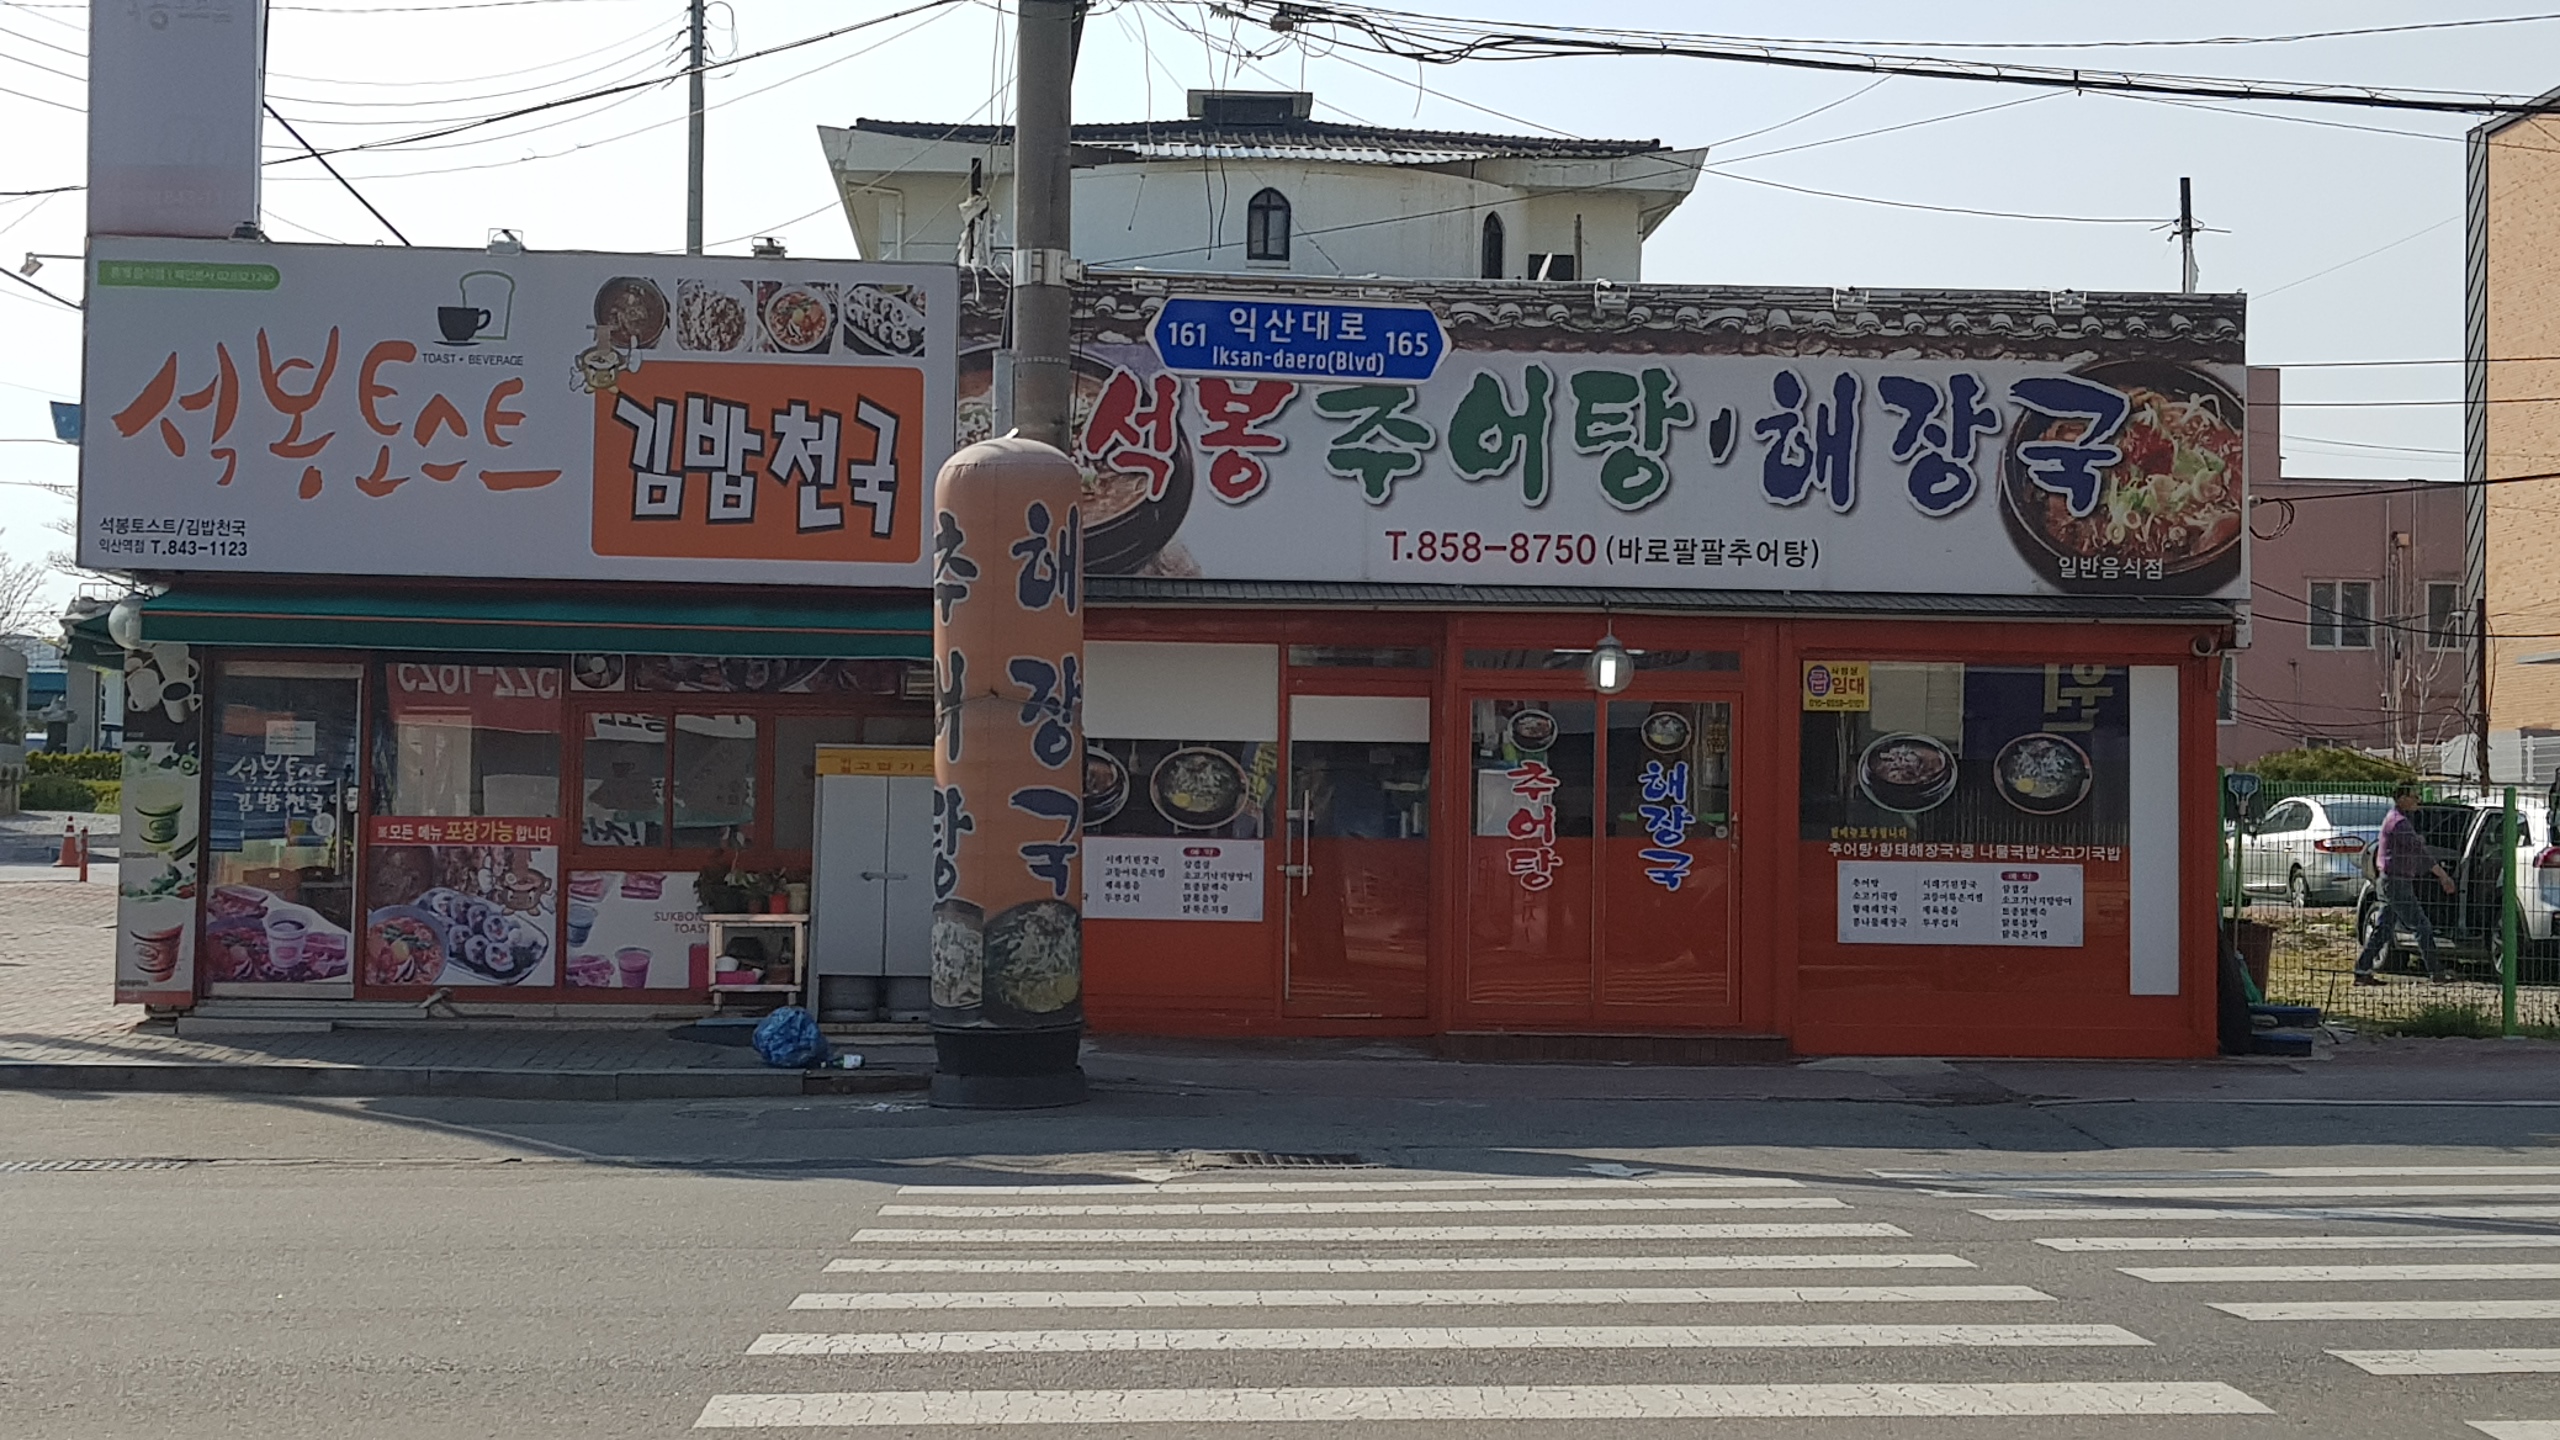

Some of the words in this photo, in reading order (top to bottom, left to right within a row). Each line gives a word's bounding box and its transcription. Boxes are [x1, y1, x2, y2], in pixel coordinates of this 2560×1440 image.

[1168, 321, 1207, 348] 161
[1228, 306, 1367, 343] 익산대로
[422, 353, 456, 366] TOAST
[468, 354, 524, 367] BEVERAGE
[1212, 345, 1385, 377] Iksan-daero(Blvd)
[1385, 331, 1429, 358] 165
[111, 325, 563, 499] 석봉토스트
[1084, 368, 1297, 502] 석봉
[613, 392, 899, 540] 김밥천국
[99, 517, 247, 537] 석봉토스트/김밥천국
[99, 539, 145, 555] 익산역점
[150, 540, 248, 558] T.843-1123
[1385, 530, 1597, 565] T.858-8750
[1604, 535, 1820, 570] (바로팔팔추어탕)
[2057, 556, 2164, 580] 일반음식점
[1010, 501, 1081, 897] 해장국
[1831, 677, 1865, 696] 임대
[1505, 760, 1563, 891] 추어탕
[1639, 760, 1696, 892] 해장국
[654, 911, 705, 922] SUKBON
